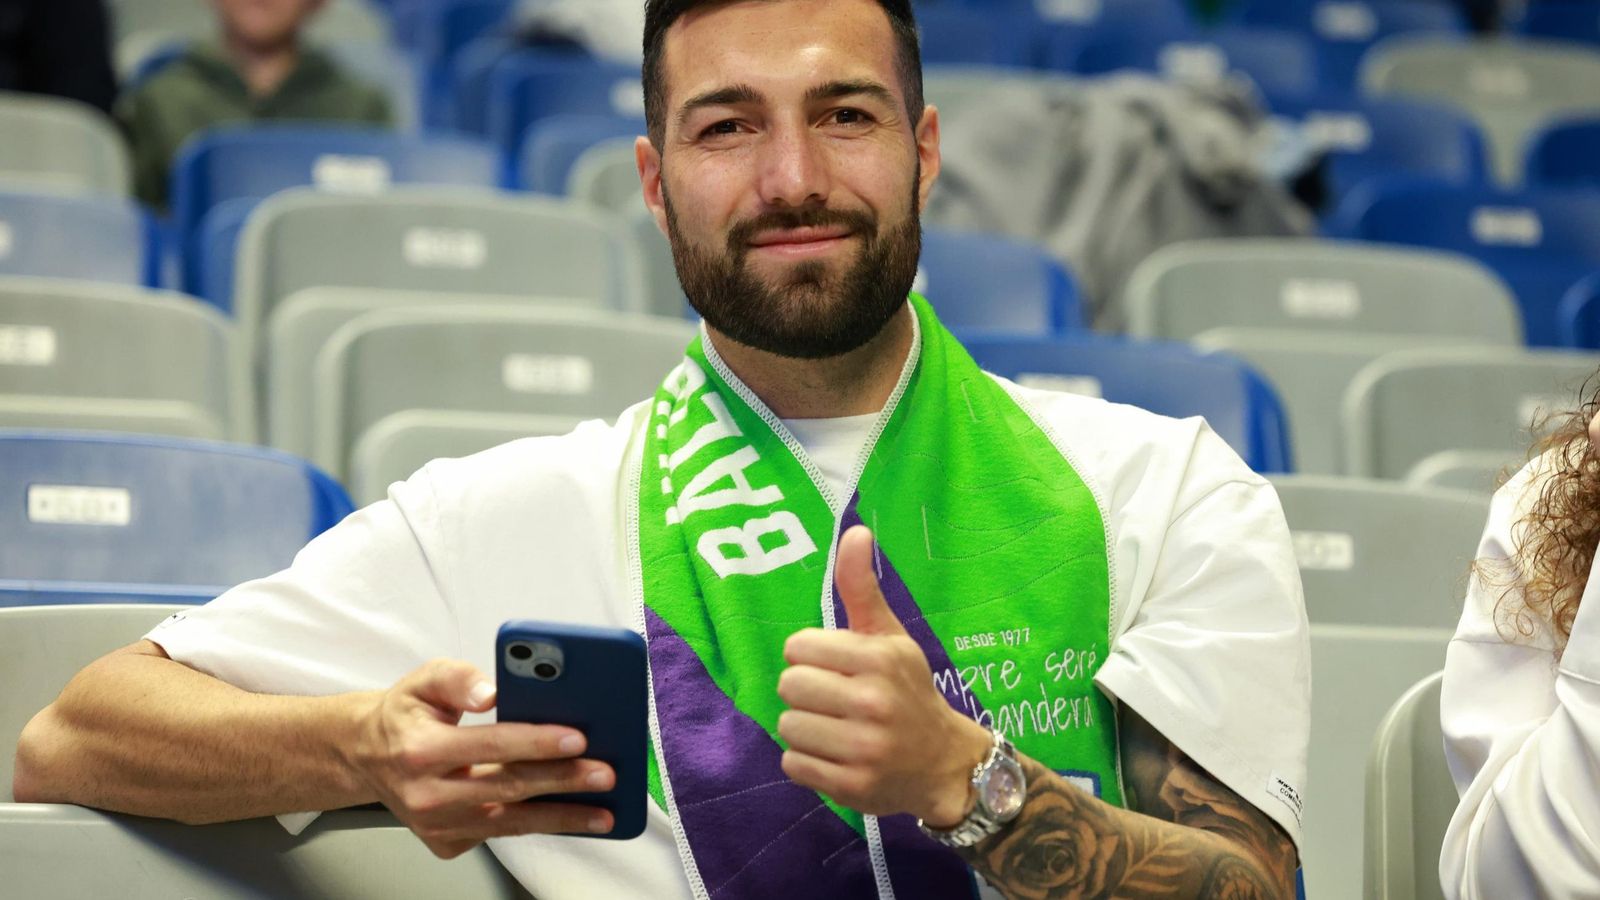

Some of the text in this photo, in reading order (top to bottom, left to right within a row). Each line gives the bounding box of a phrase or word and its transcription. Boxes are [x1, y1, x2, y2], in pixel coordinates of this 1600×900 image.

[954, 627, 1030, 651] DESDE 1977
[1045, 643, 1097, 682] seré
